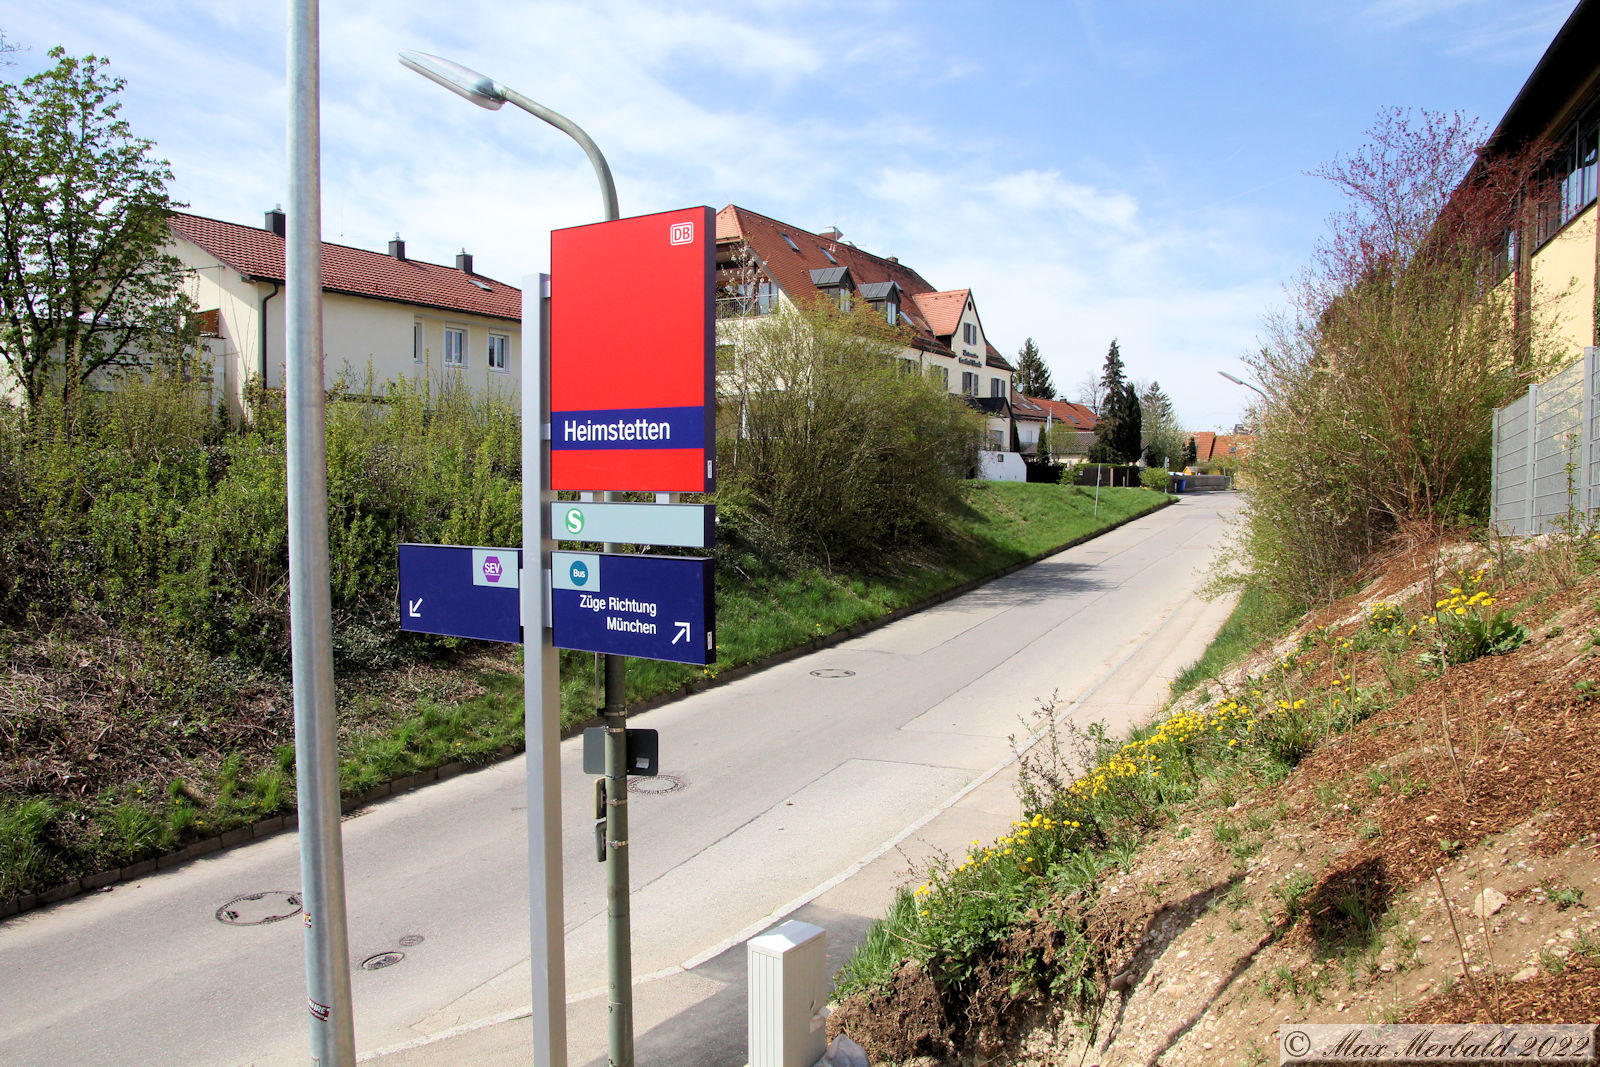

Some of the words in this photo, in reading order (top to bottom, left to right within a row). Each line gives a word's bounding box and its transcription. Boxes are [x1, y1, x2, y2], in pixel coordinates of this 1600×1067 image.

[674, 226, 690, 241] DB
[564, 419, 671, 441] Heimstetten
[567, 509, 582, 533] S
[484, 562, 500, 574] SEV
[573, 568, 586, 578] Bus
[579, 594, 606, 612] Züge
[608, 597, 657, 617] Richtung
[606, 616, 657, 634] München
